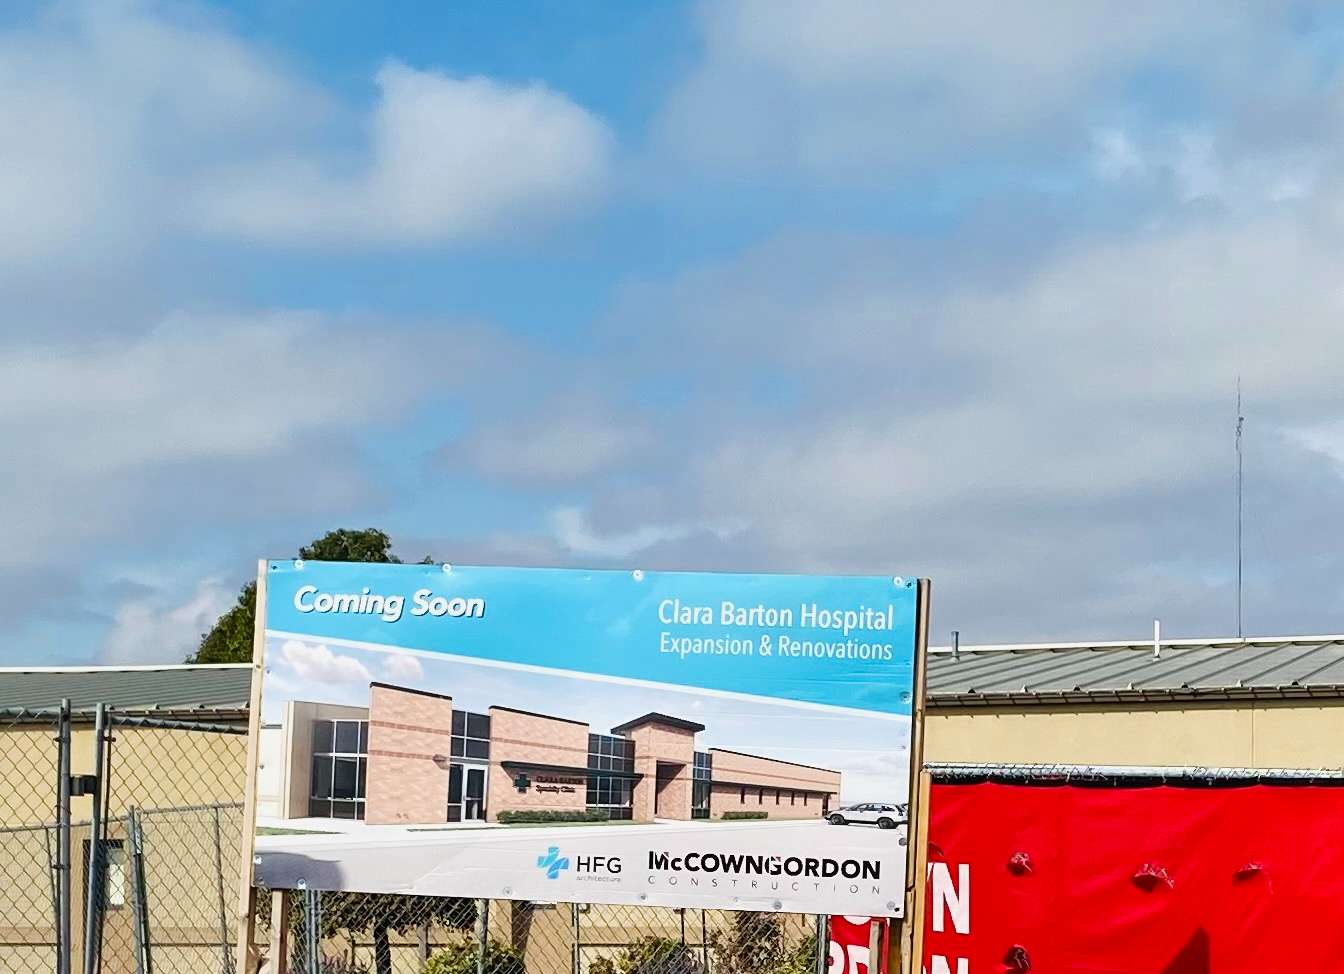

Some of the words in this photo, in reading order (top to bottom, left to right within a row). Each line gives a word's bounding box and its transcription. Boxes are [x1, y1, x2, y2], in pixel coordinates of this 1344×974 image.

[294, 585, 405, 623] Coming
[410, 589, 486, 618] Soon
[658, 599, 713, 625] Clara
[720, 601, 793, 628] Barton
[800, 603, 894, 636] Hospital
[660, 632, 753, 659] Expansion
[759, 634, 772, 657] &
[778, 635, 893, 660] Renovations
[577, 855, 622, 874] HFG
[648, 850, 881, 880] McCOWNGORDON
[648, 875, 880, 895] CONSTRUCTION
